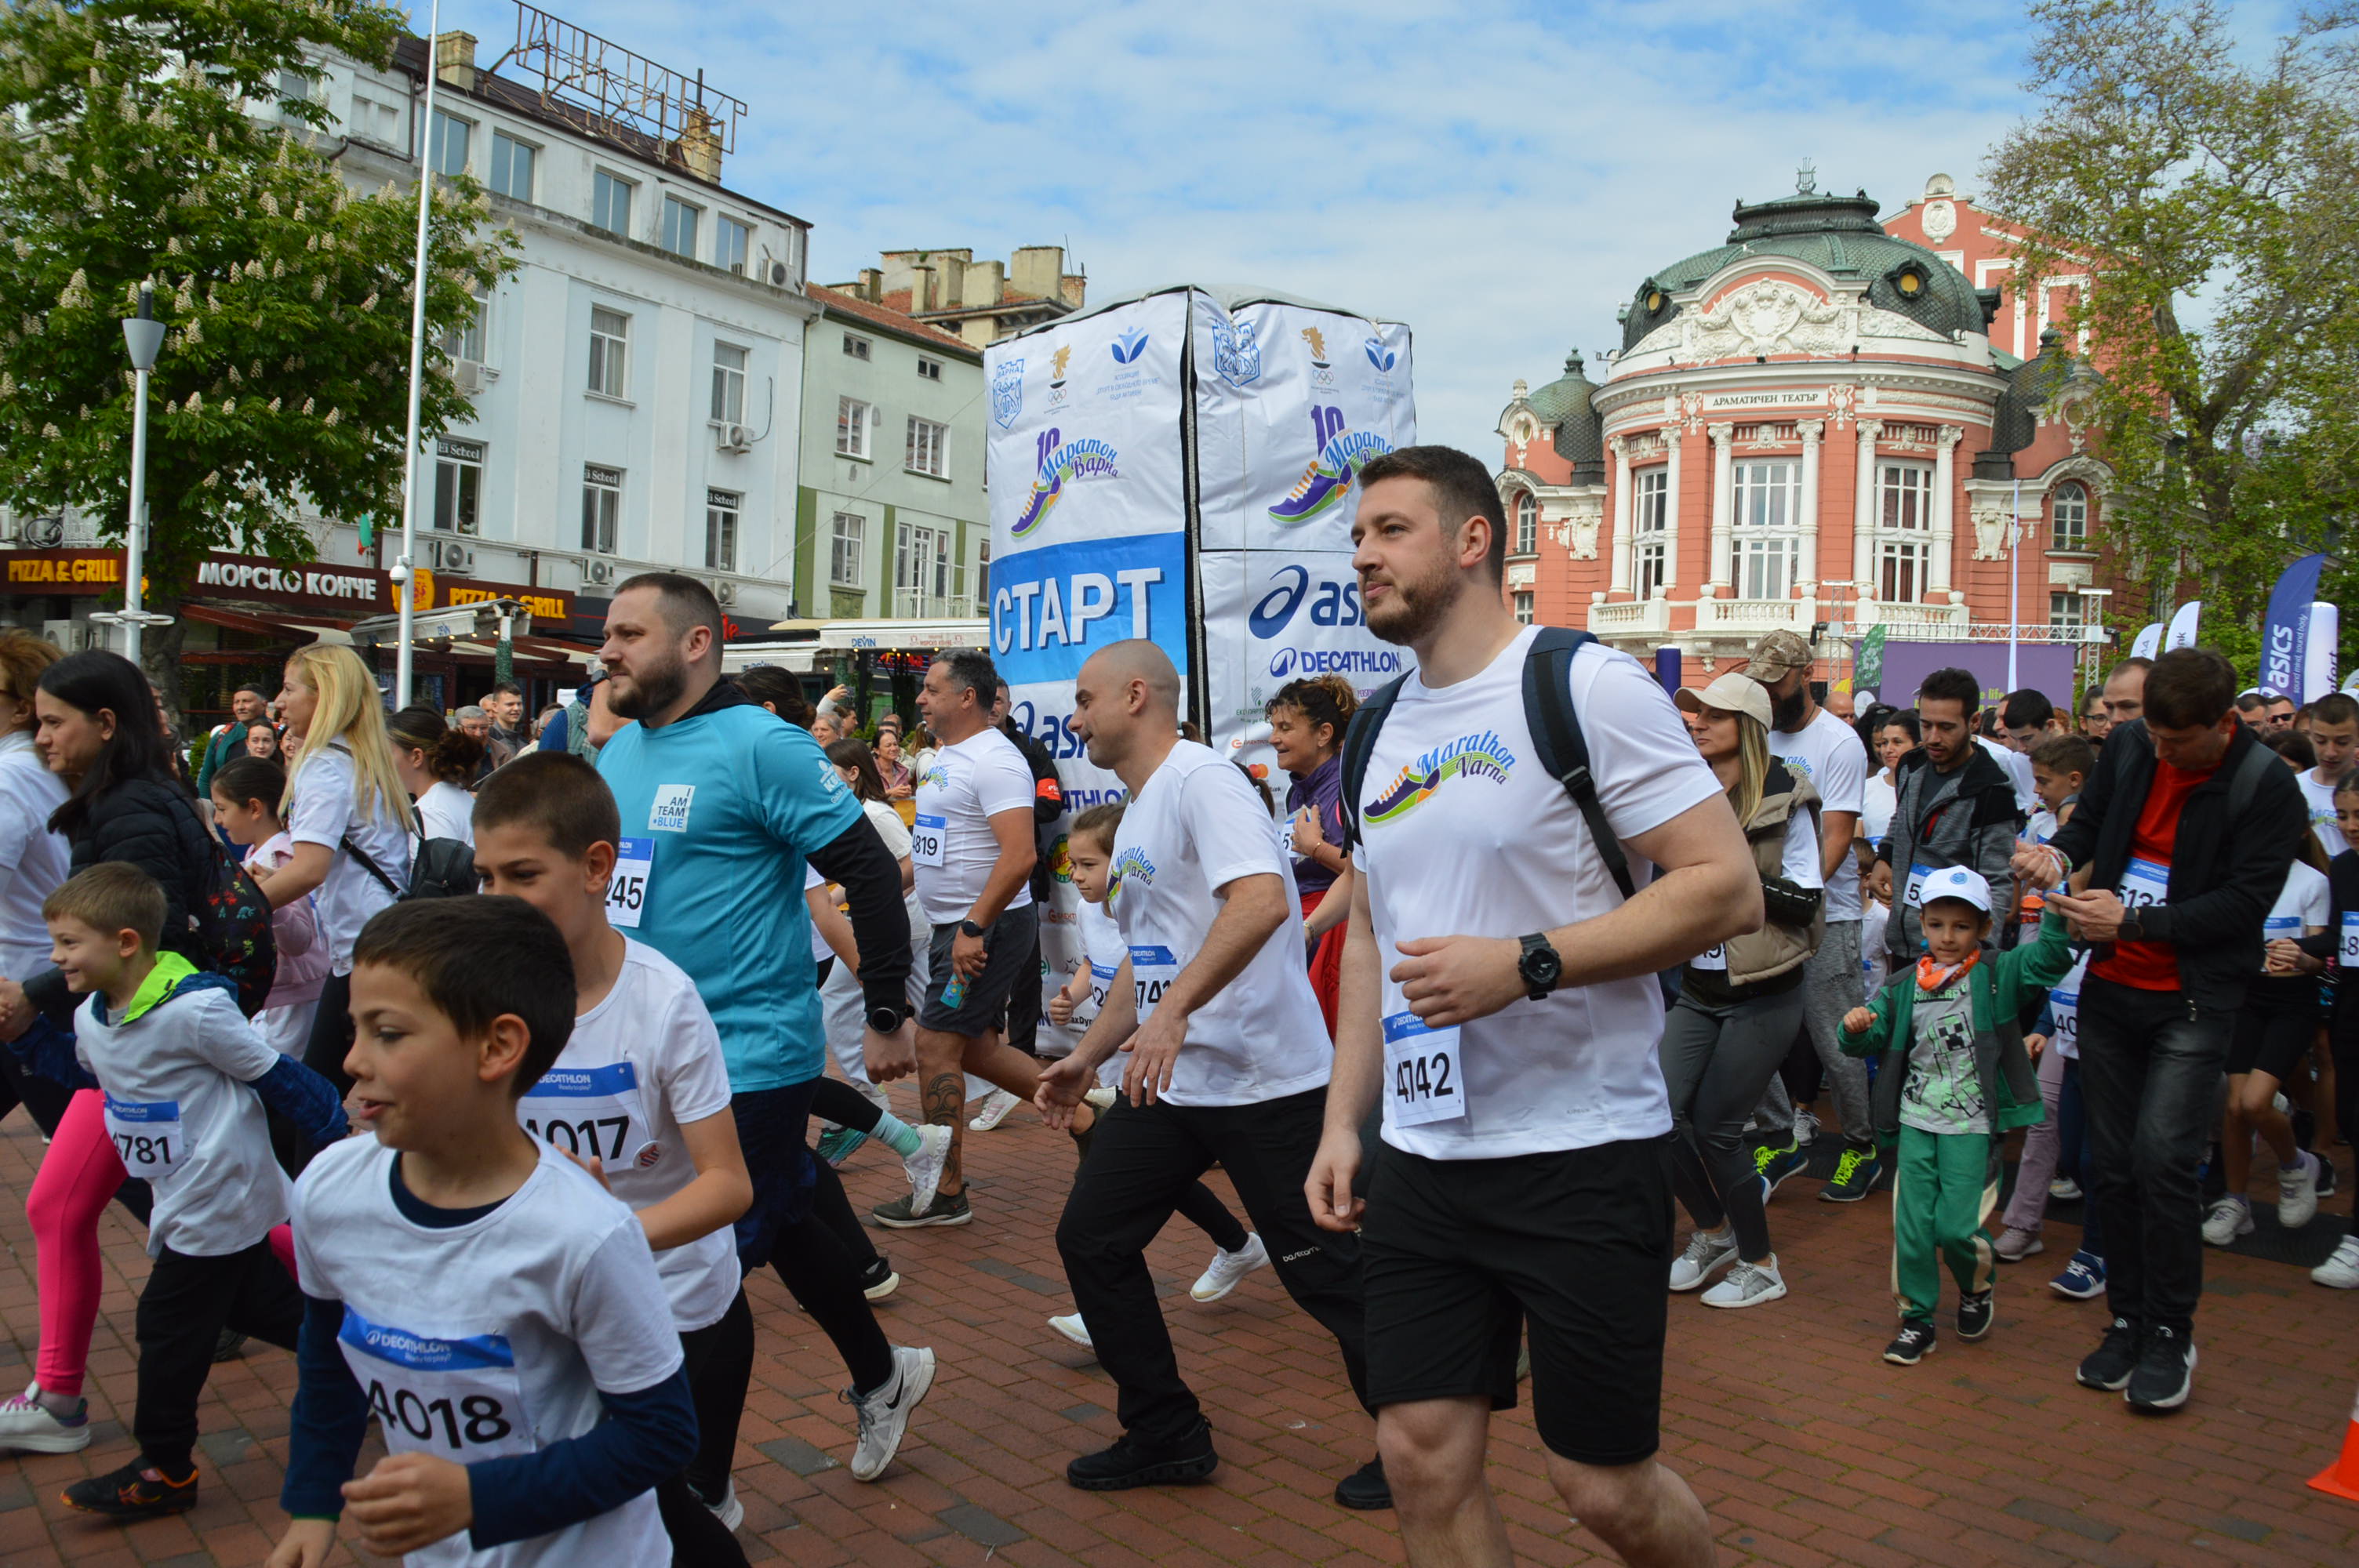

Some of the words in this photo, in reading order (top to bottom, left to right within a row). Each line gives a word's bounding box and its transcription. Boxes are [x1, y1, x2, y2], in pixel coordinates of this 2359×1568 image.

[1713, 394, 1778, 406] ДРАМАТИЧЕН
[1782, 394, 1819, 402] ТЕАТЪР
[1041, 438, 1118, 487] Маратон
[1071, 456, 1118, 480] Варна
[8, 560, 56, 582] PIZZA
[71, 559, 119, 582] GRILL
[198, 561, 303, 593] МОРСКО
[306, 572, 377, 601] КОНЧЕ
[519, 595, 566, 619] GRILL
[994, 567, 1165, 655] СТАРТ
[1301, 651, 1401, 673] DECATHLON
[2267, 624, 2293, 689] asics
[1417, 730, 1515, 779] Marathon
[1456, 753, 1507, 785] Varna
[670, 797, 688, 807] AM
[686, 788, 691, 797] I
[657, 818, 684, 828] BLUE
[658, 806, 685, 817] TEAM
[539, 1073, 591, 1083] DECATHLON
[1397, 1052, 1454, 1104] 4742
[381, 1334, 451, 1354] DECATHLON
[367, 1377, 512, 1450] 4018
